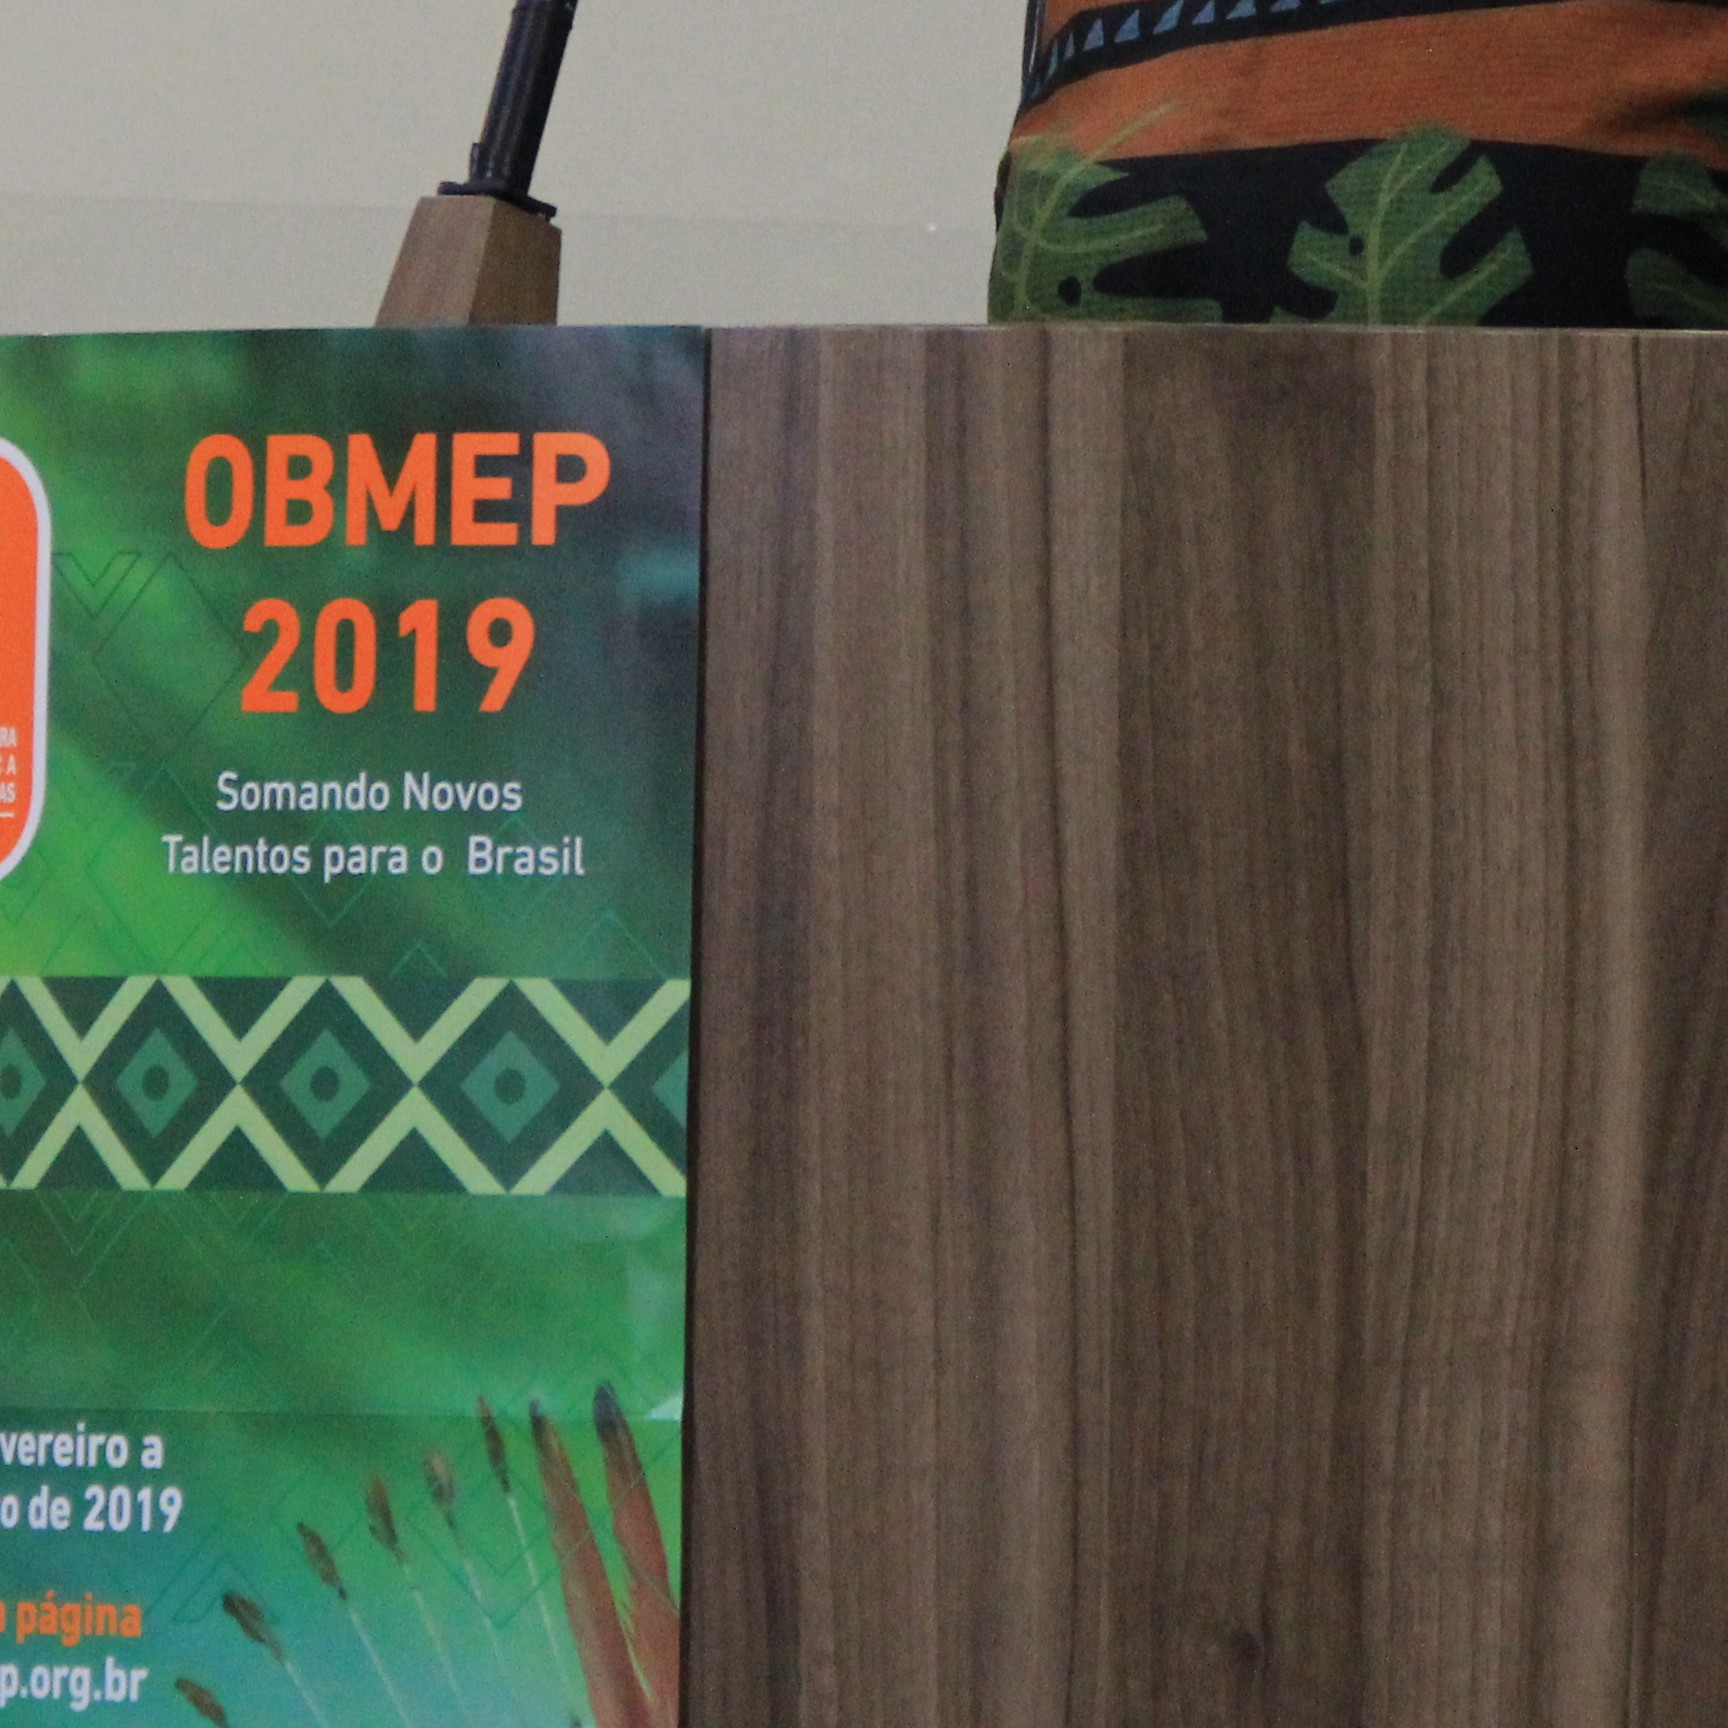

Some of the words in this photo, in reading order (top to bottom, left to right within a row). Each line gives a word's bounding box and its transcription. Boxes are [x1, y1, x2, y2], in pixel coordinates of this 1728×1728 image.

[184, 431, 611, 549] OBMEP
[241, 597, 535, 714] 2019
[216, 770, 391, 811] Somando
[403, 771, 523, 812] Novos
[161, 833, 312, 875] Talentos
[323, 843, 410, 884] para
[421, 844, 445, 875] o
[467, 834, 586, 876] Brasil
[140, 1434, 165, 1469] a
[28, 1484, 72, 1530] de
[83, 1483, 184, 1533] 2019
[16, 1589, 142, 1646] página
